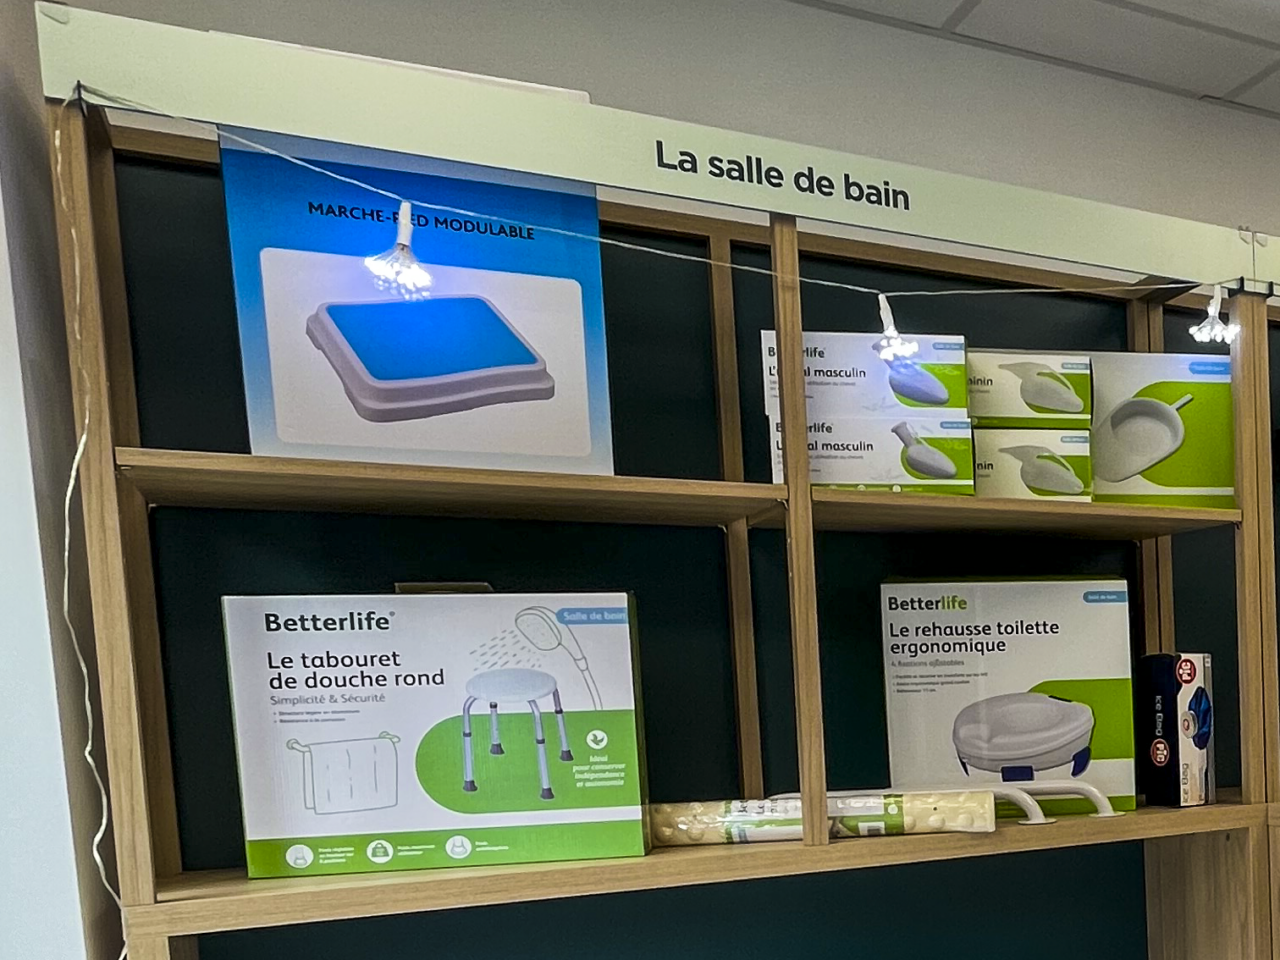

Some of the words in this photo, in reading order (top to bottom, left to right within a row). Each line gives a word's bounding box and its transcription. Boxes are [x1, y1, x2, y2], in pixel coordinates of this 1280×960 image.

[656, 140, 698, 174] La
[708, 155, 784, 188] salle
[793, 166, 835, 197] de
[844, 173, 910, 210] bain
[308, 202, 429, 228] MARCHE-PED
[434, 216, 535, 240] MODULABLE
[813, 367, 867, 378] masculin
[821, 441, 874, 452] masculin
[888, 595, 967, 610] Betterlife
[265, 611, 390, 632] Betterlife
[889, 622, 910, 638] Le
[915, 622, 992, 637] rehausse
[996, 620, 1060, 635] toilette
[890, 638, 1007, 658] ergonomique
[267, 652, 294, 669] Le
[300, 651, 401, 669] tabouret
[269, 672, 298, 690] de
[304, 670, 388, 689] douche
[394, 668, 445, 686] rond
[270, 694, 326, 706] Simplicité
[328, 694, 338, 704] &
[340, 693, 386, 704] Sécurité
